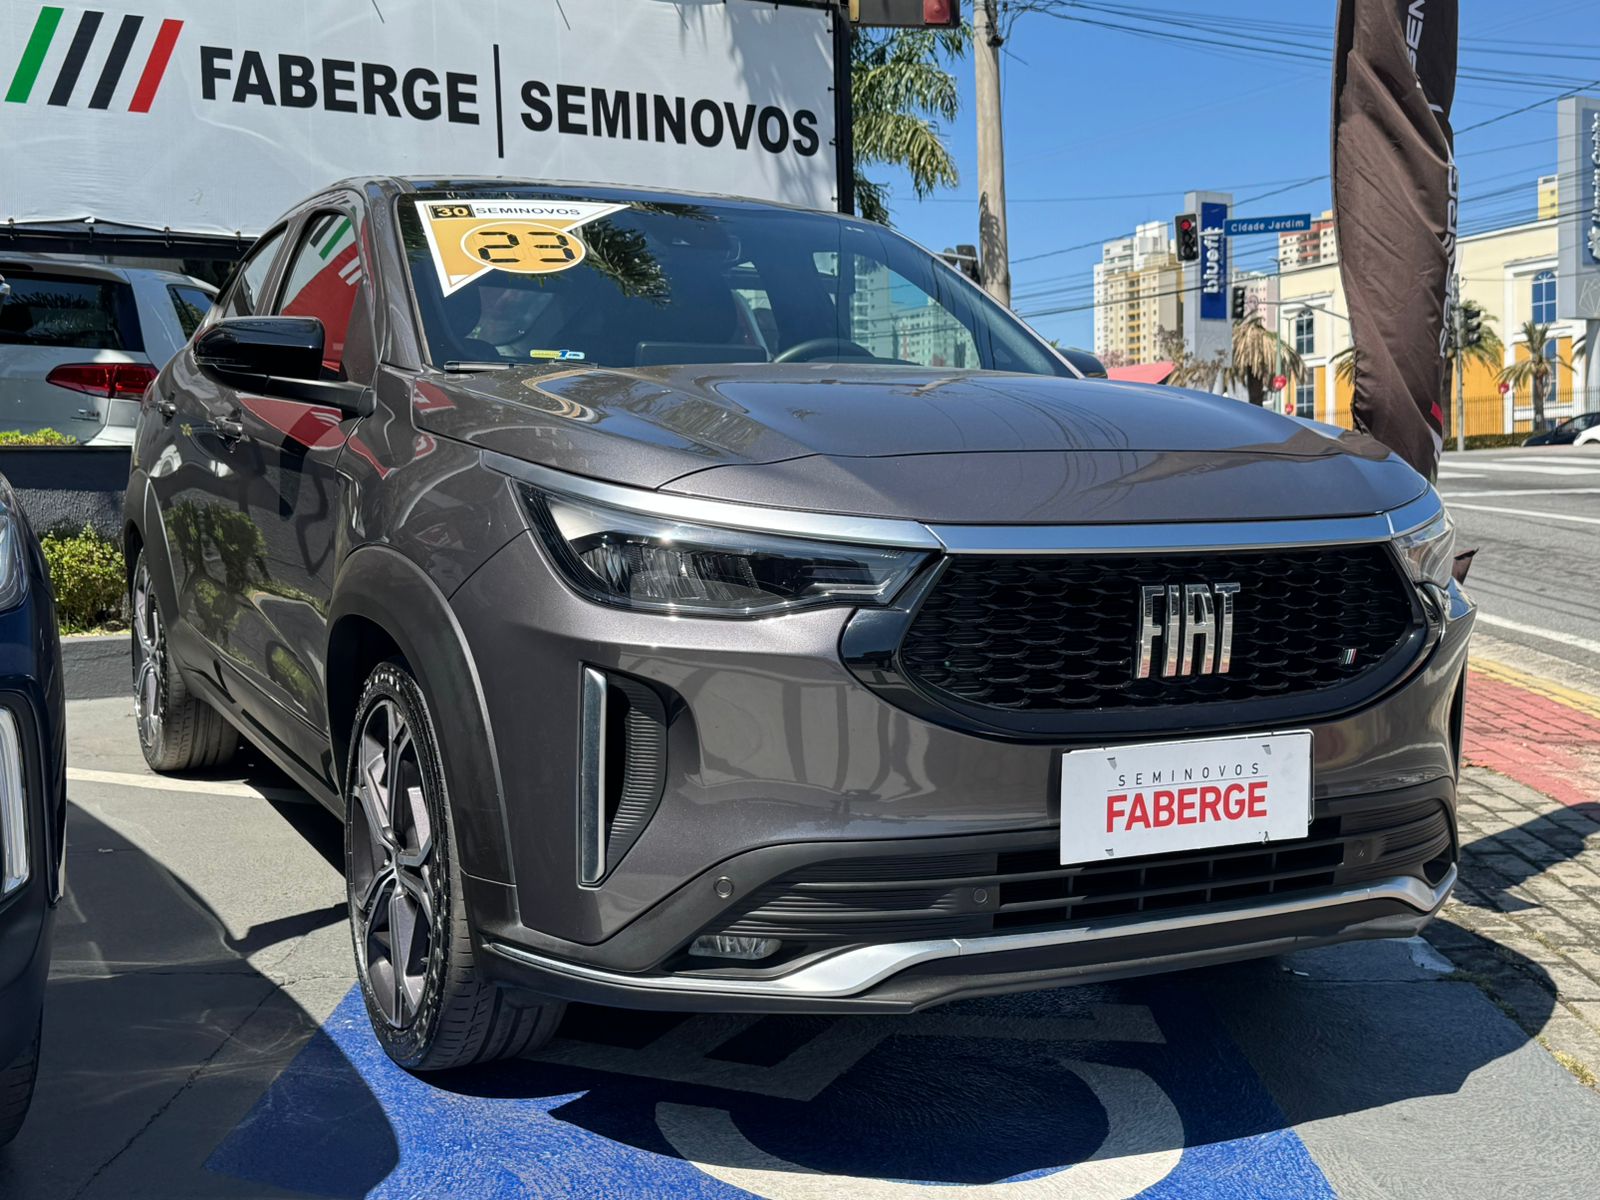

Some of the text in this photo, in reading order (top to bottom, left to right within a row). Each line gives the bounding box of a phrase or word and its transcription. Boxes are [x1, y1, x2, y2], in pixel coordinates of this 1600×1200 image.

[200, 45, 820, 157] FABERGE SEMINOVOS
[436, 206, 581, 217] 30 SEMINOVOS
[1230, 219, 1305, 233] Cidade Jardim
[477, 231, 576, 264] 23
[1135, 582, 1241, 679] FIAT
[1118, 762, 1260, 787] SEMINOVOS
[1106, 781, 1268, 833] FABERGE
